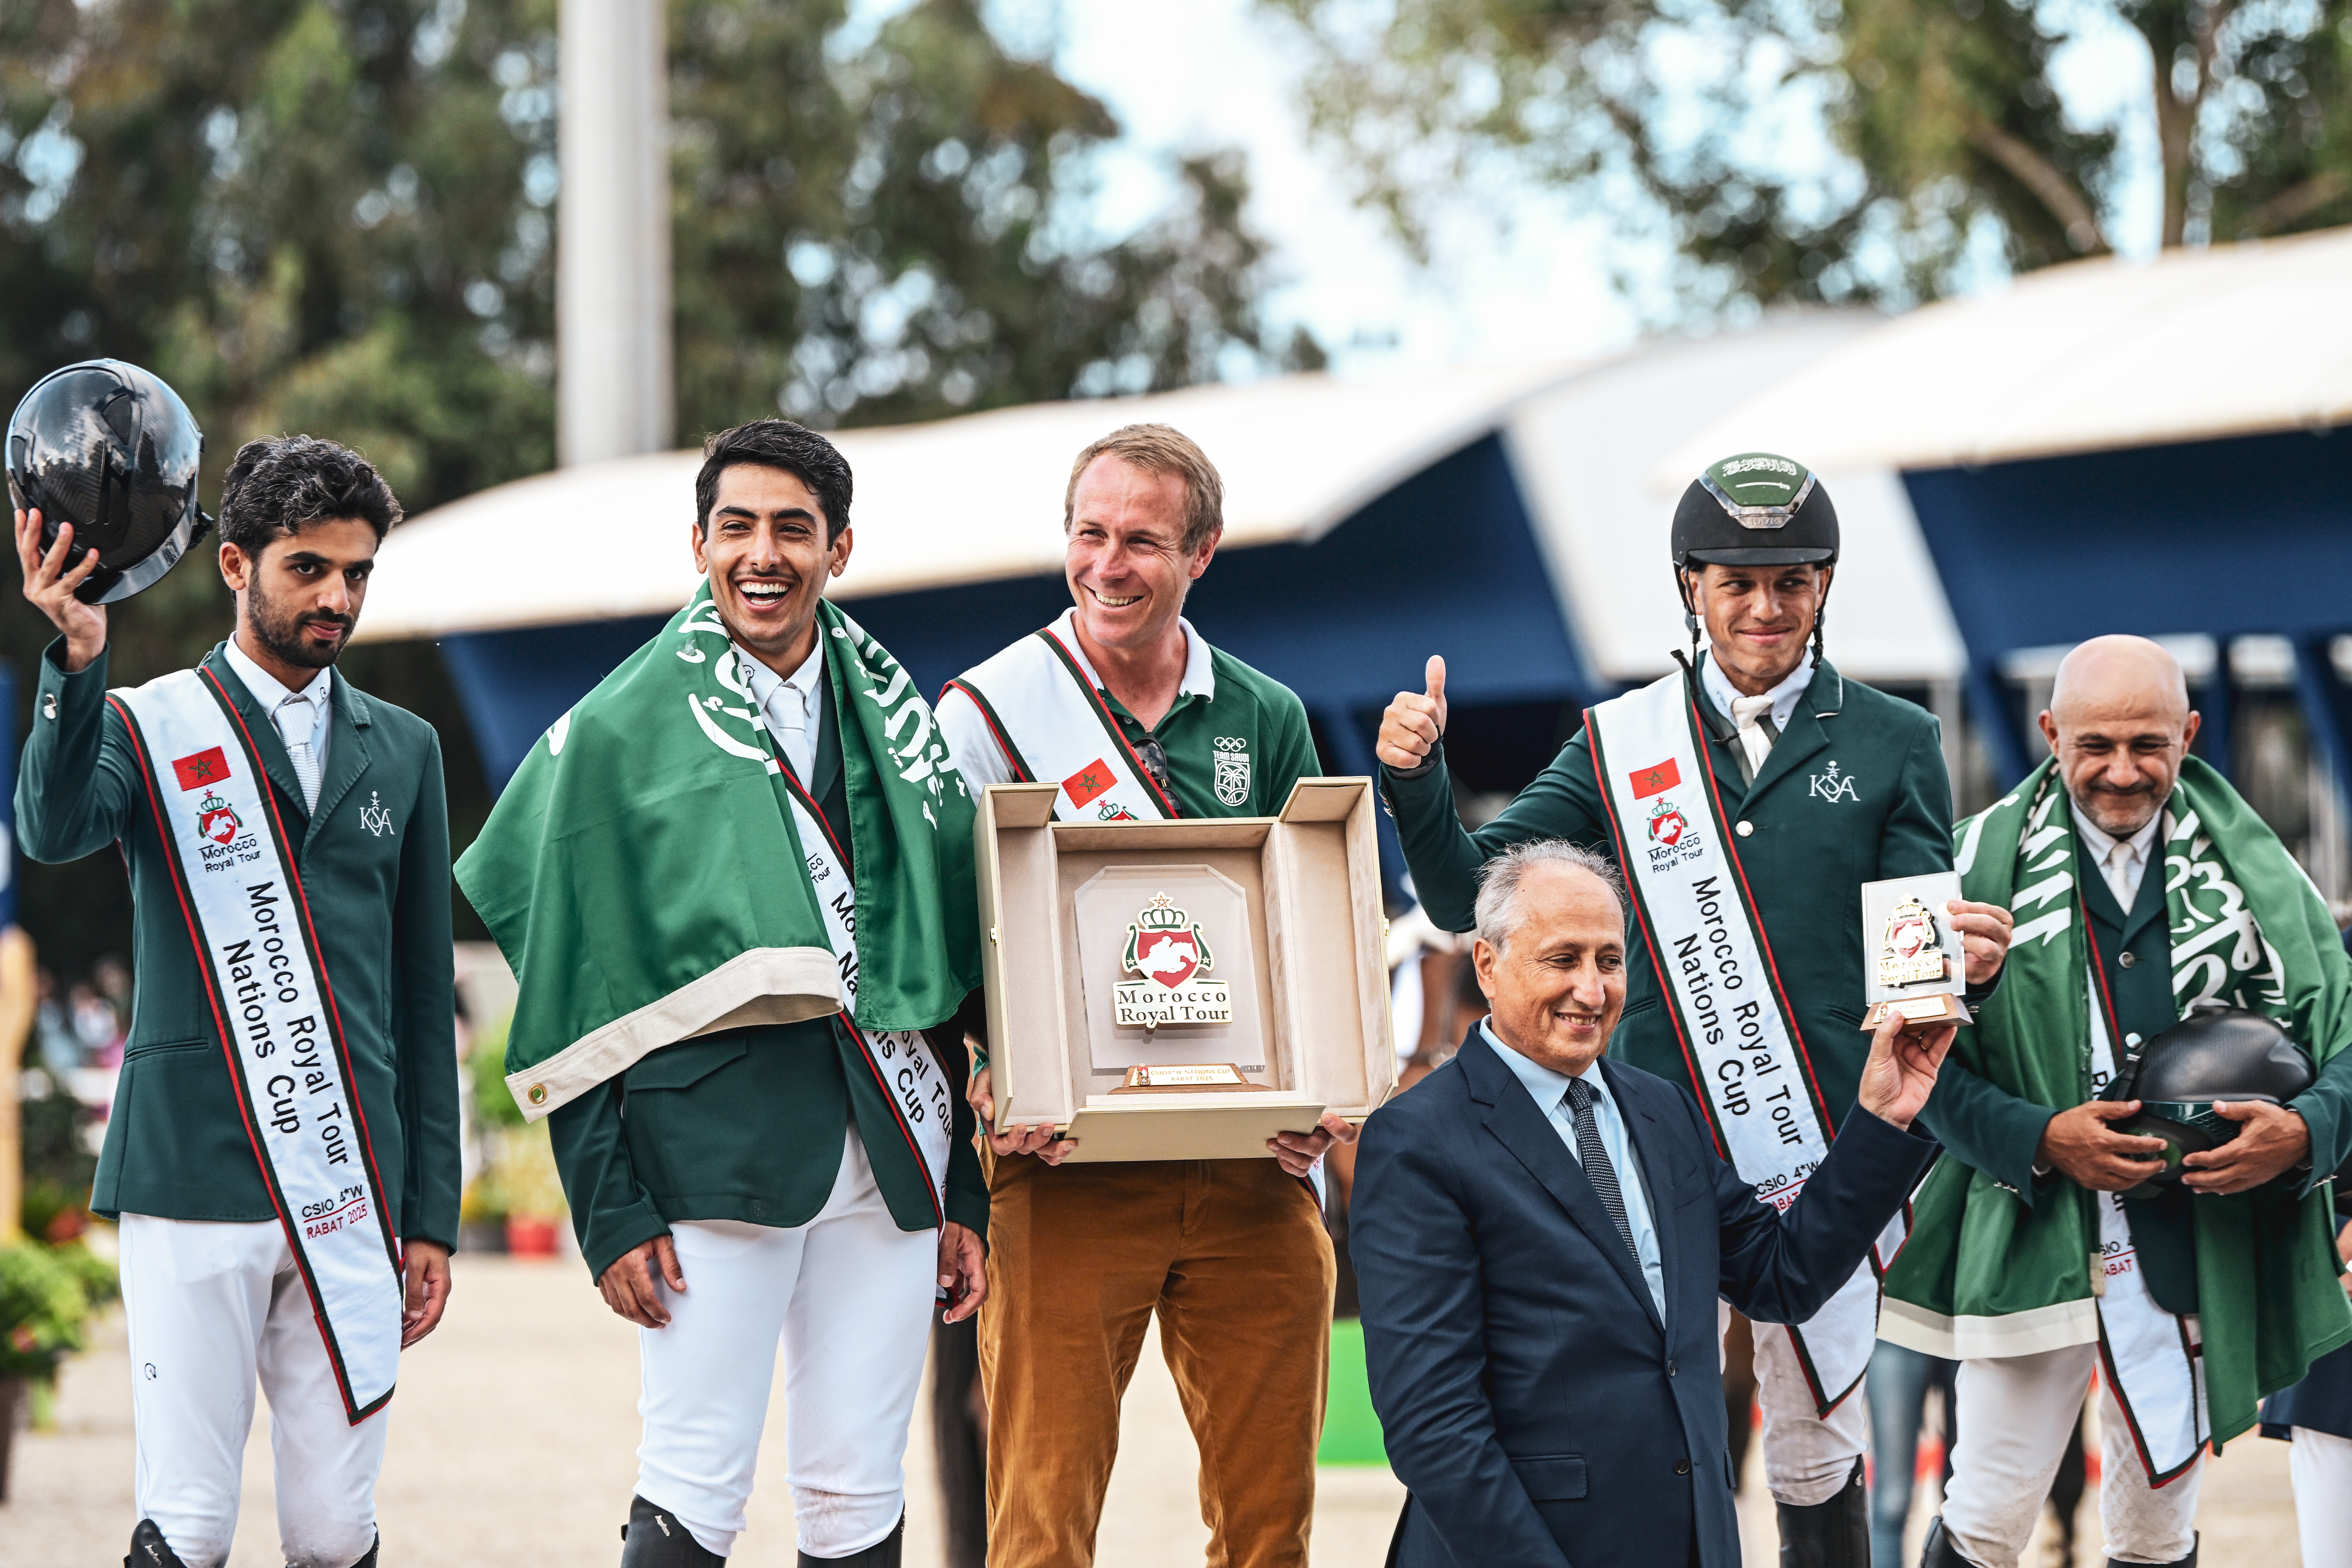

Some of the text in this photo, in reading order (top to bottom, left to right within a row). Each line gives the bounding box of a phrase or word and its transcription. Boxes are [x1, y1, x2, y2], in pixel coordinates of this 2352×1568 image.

[1212, 750, 1250, 763] TEAM SAUDI
[1809, 774, 1860, 803] KSA
[359, 807, 395, 837] KSA
[198, 838, 257, 861] Morocco
[205, 849, 261, 873] Royal Tour
[1648, 836, 1701, 863] Morocco
[1652, 847, 1704, 873] Royal Tour
[812, 866, 831, 884] Tour
[1880, 957, 1940, 971] Morocco
[1881, 970, 1942, 984] Royal Tour
[1117, 990, 1227, 1004] Morocco
[1120, 1006, 1228, 1025] Royal Tour
[1692, 876, 1802, 1145] Morocco Royal Tour
[247, 881, 348, 1165] Morocco Royal Tour
[1673, 933, 1750, 1117] Nations Cup
[223, 939, 300, 1134] Nations Cup
[898, 1068, 925, 1123] Cup
[902, 1030, 952, 1141] oyal Tour
[1756, 1174, 1787, 1195] CSIO
[301, 1198, 334, 1218] CSIO
[306, 1204, 368, 1240] RABAT 2025
[2100, 1241, 2120, 1255] SIO
[2104, 1259, 2132, 1277] ABAT
